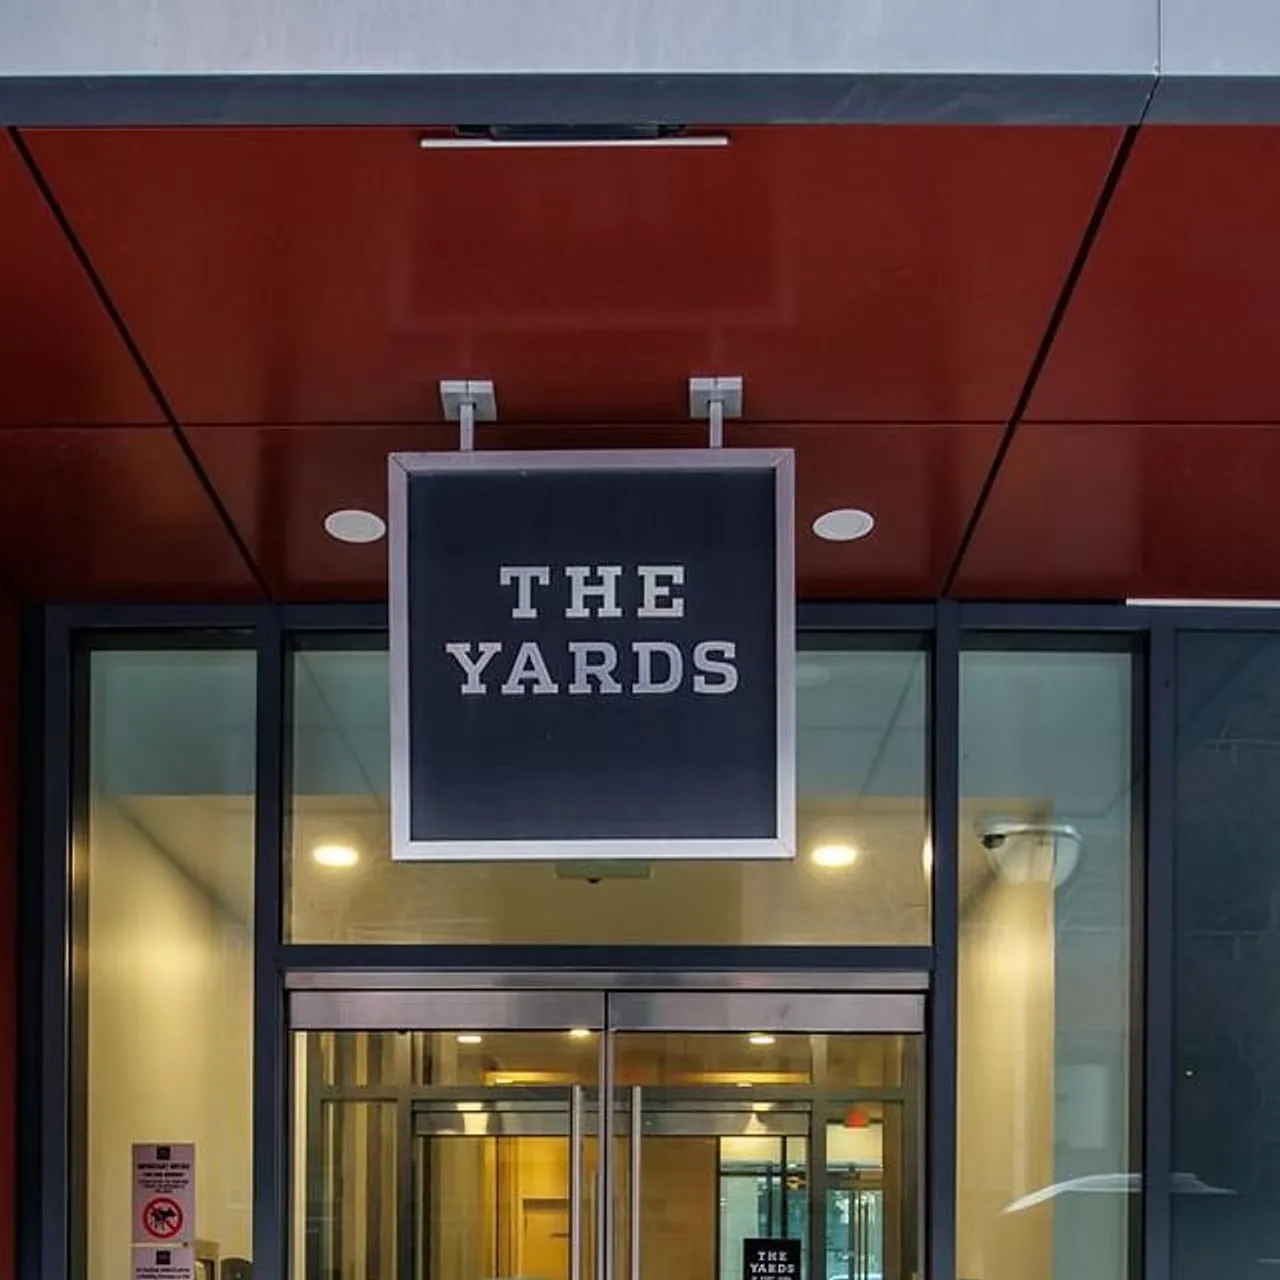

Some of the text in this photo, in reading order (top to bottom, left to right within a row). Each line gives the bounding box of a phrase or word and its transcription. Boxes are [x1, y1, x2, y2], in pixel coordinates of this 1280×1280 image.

[500, 565, 686, 619] THE
[445, 641, 739, 695] YARDS
[757, 1251, 788, 1261] THE
